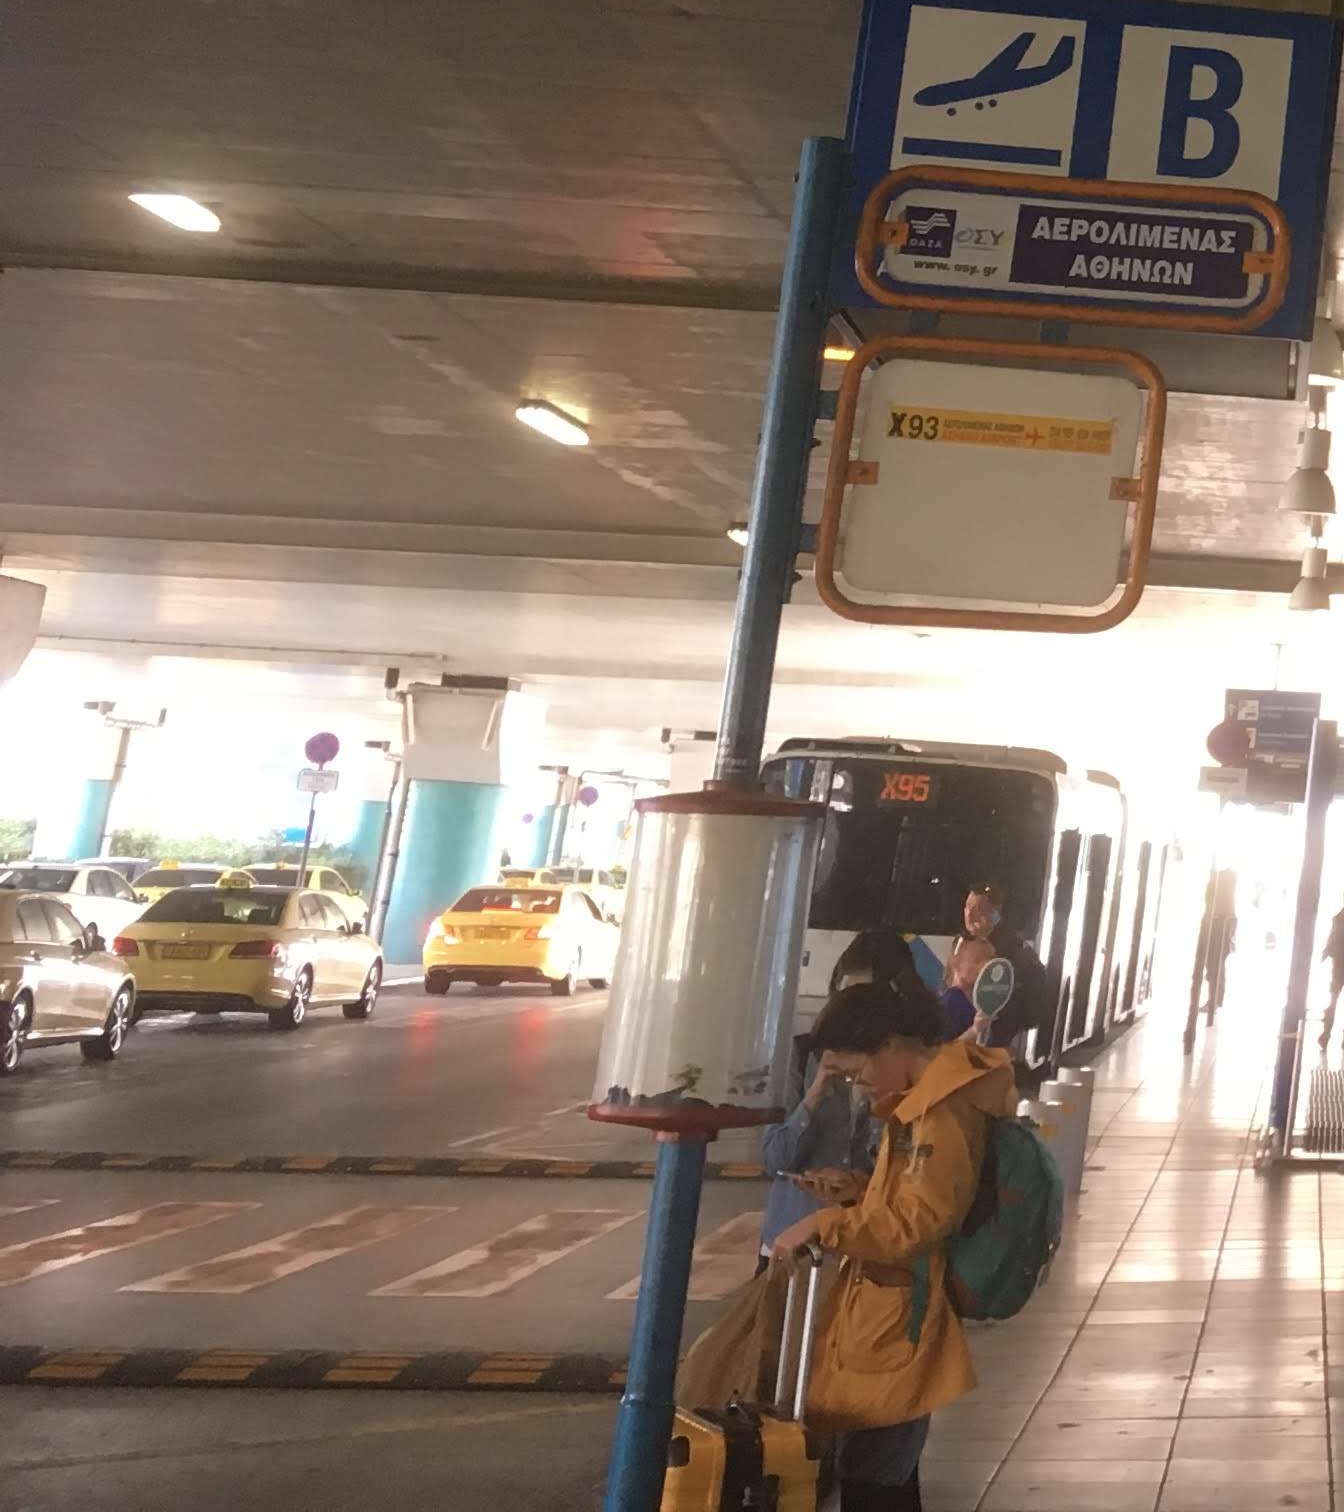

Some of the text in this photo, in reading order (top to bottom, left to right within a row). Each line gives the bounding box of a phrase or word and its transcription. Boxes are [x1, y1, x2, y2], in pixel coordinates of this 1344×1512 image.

[1156, 44, 1244, 179] B
[1032, 216, 1237, 254] ΑΕΡΟΛΙΜΕΝΑΣ
[1068, 253, 1194, 286] ΑΘΗΝΩΝ
[888, 411, 940, 441] X93
[880, 772, 931, 802] X95
